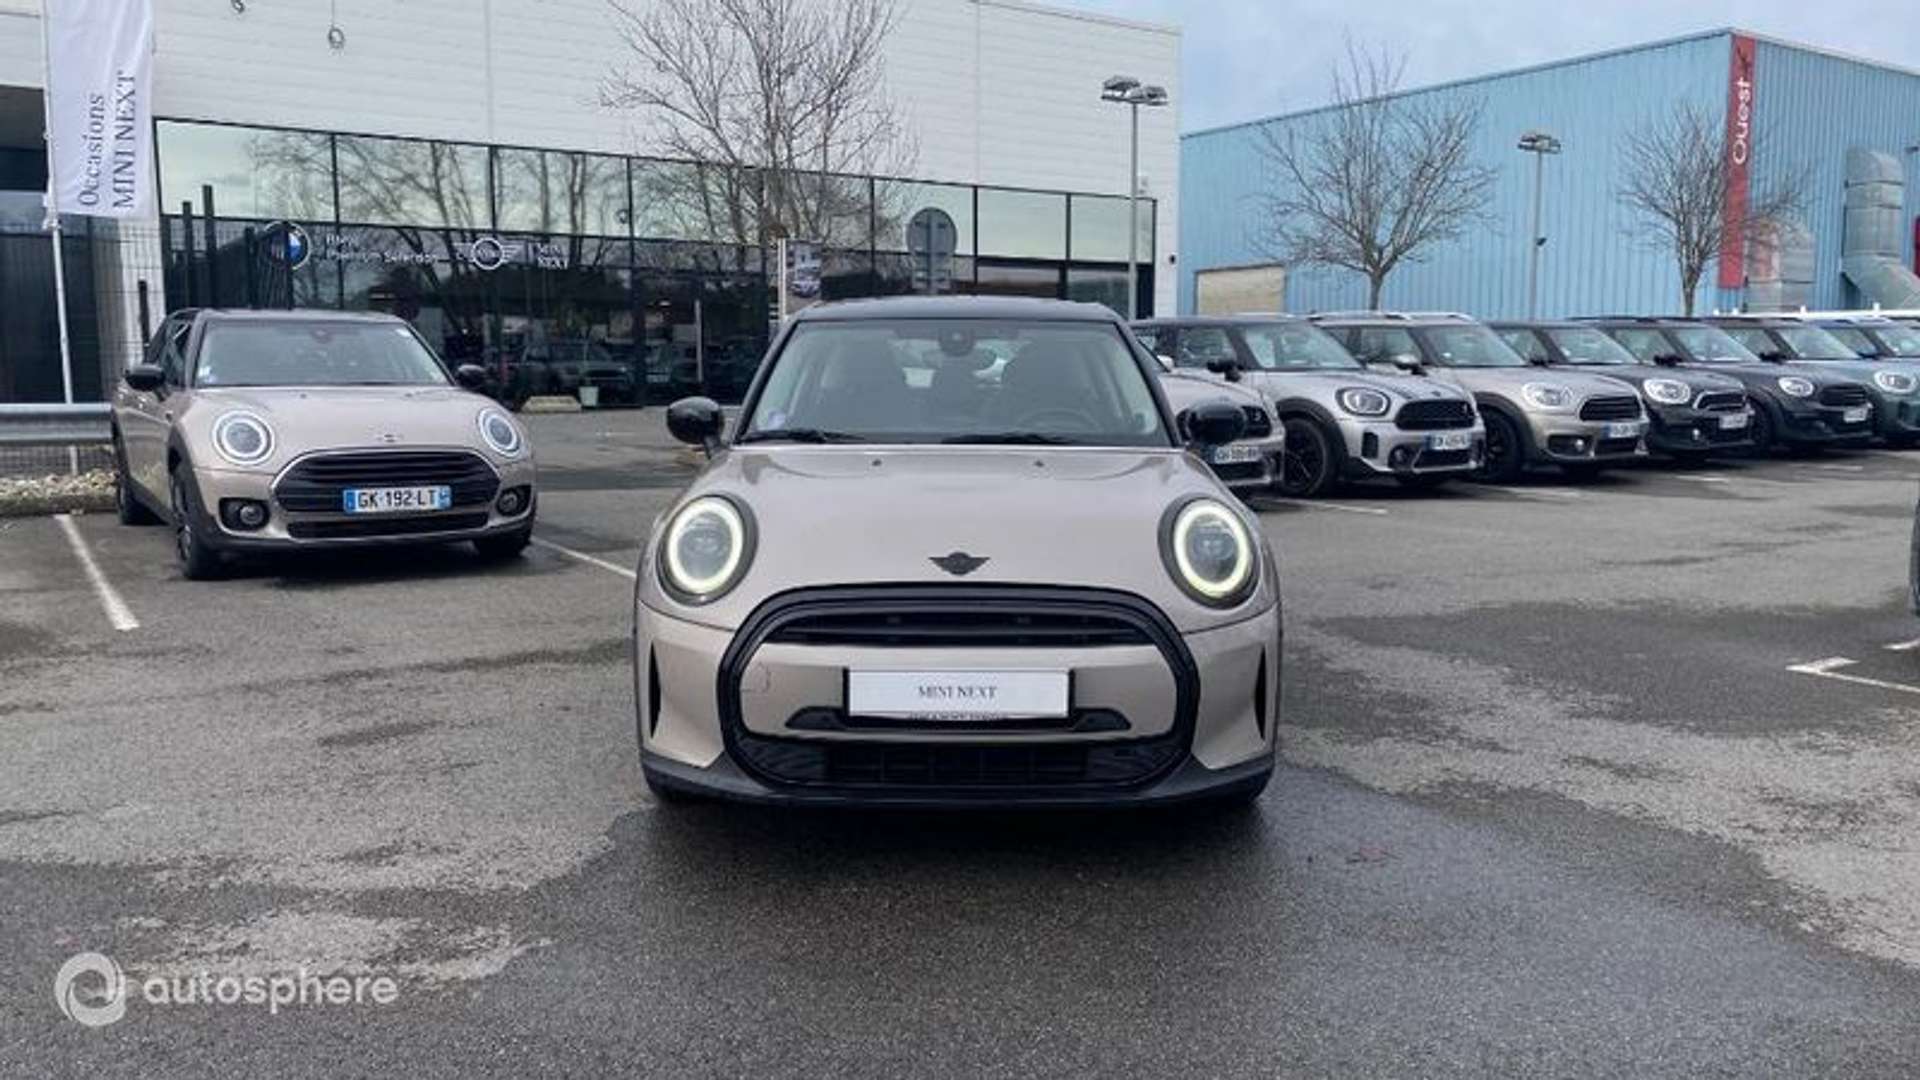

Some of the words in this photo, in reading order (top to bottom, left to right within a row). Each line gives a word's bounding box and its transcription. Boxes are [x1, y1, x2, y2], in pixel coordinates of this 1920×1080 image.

[114, 69, 136, 141] NEXT
[1732, 76, 1752, 166] Ouest
[78, 92, 105, 207] Occasions
[113, 149, 136, 209] MINI
[917, 685, 953, 699] MINI
[957, 685, 998, 699] NEXT
